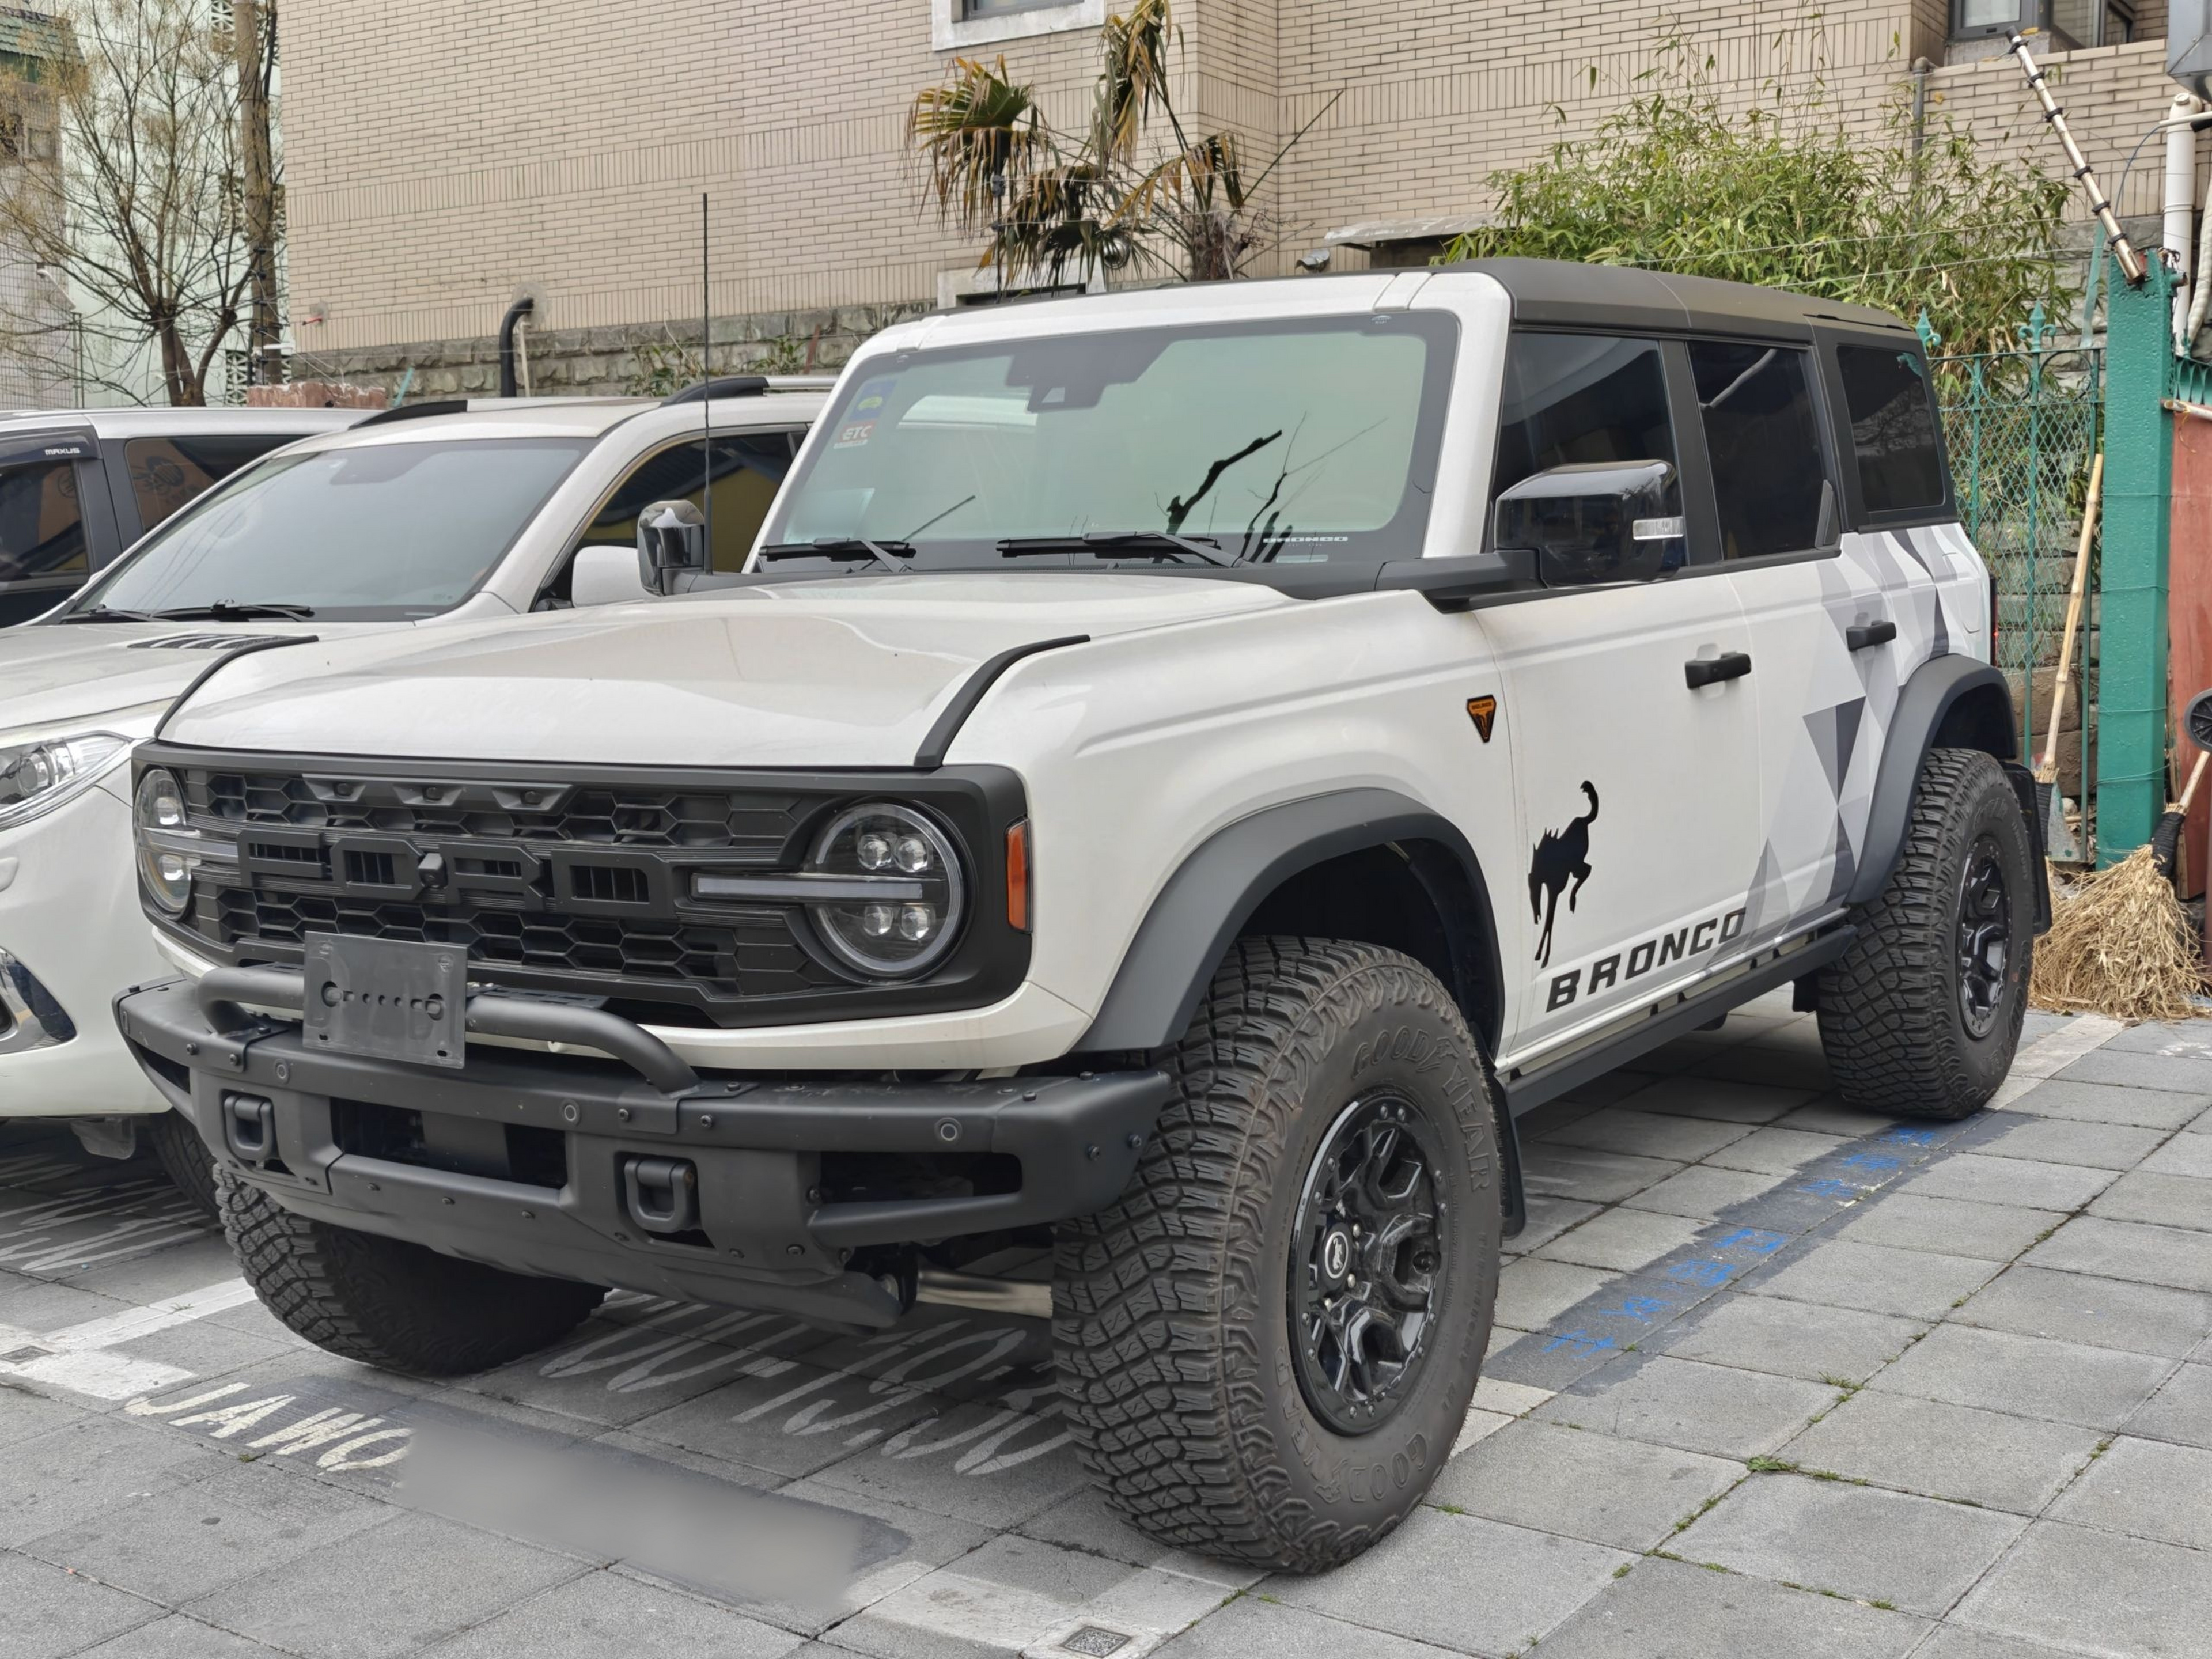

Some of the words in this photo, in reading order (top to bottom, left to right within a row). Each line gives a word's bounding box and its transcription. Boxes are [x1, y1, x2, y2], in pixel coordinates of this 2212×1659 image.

[45, 447, 80, 455] MAXUS
[842, 425, 872, 441] ETC
[237, 828, 675, 919] FORD
[1546, 907, 1747, 1013] BRONCO
[1351, 1025, 1491, 1192] GOODYEAR
